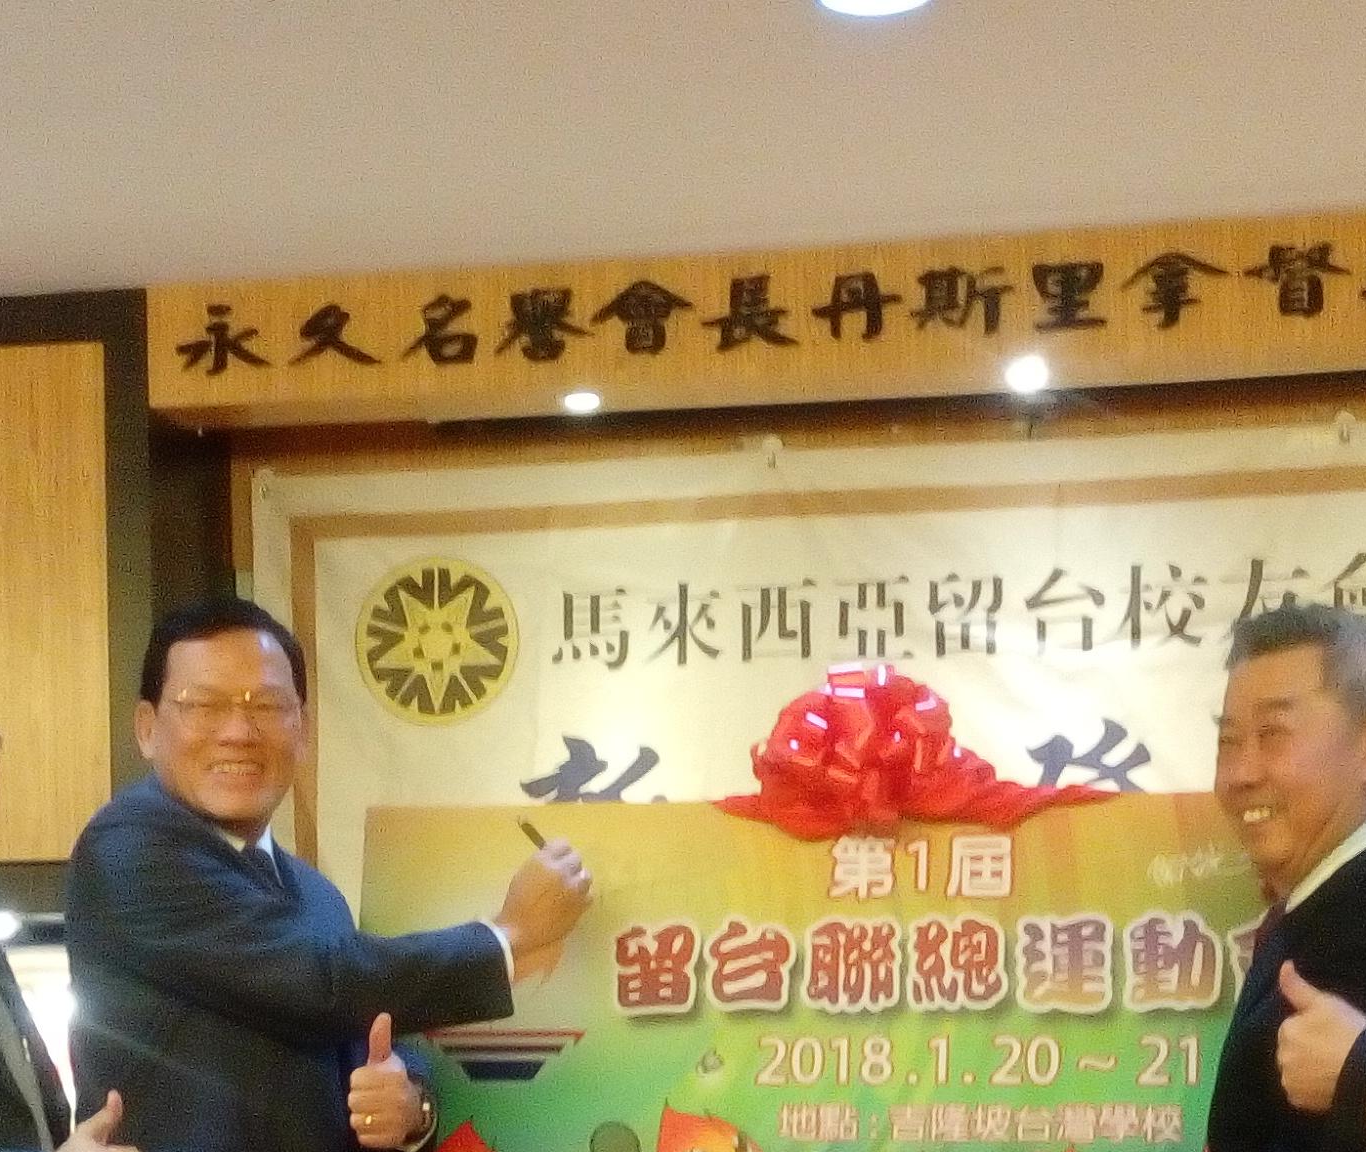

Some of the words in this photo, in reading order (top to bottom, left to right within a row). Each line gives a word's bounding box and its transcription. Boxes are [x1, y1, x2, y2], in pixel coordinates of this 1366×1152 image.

[829, 833, 1014, 899] 第1屆
[611, 912, 1259, 1016] 留台聯總運動
